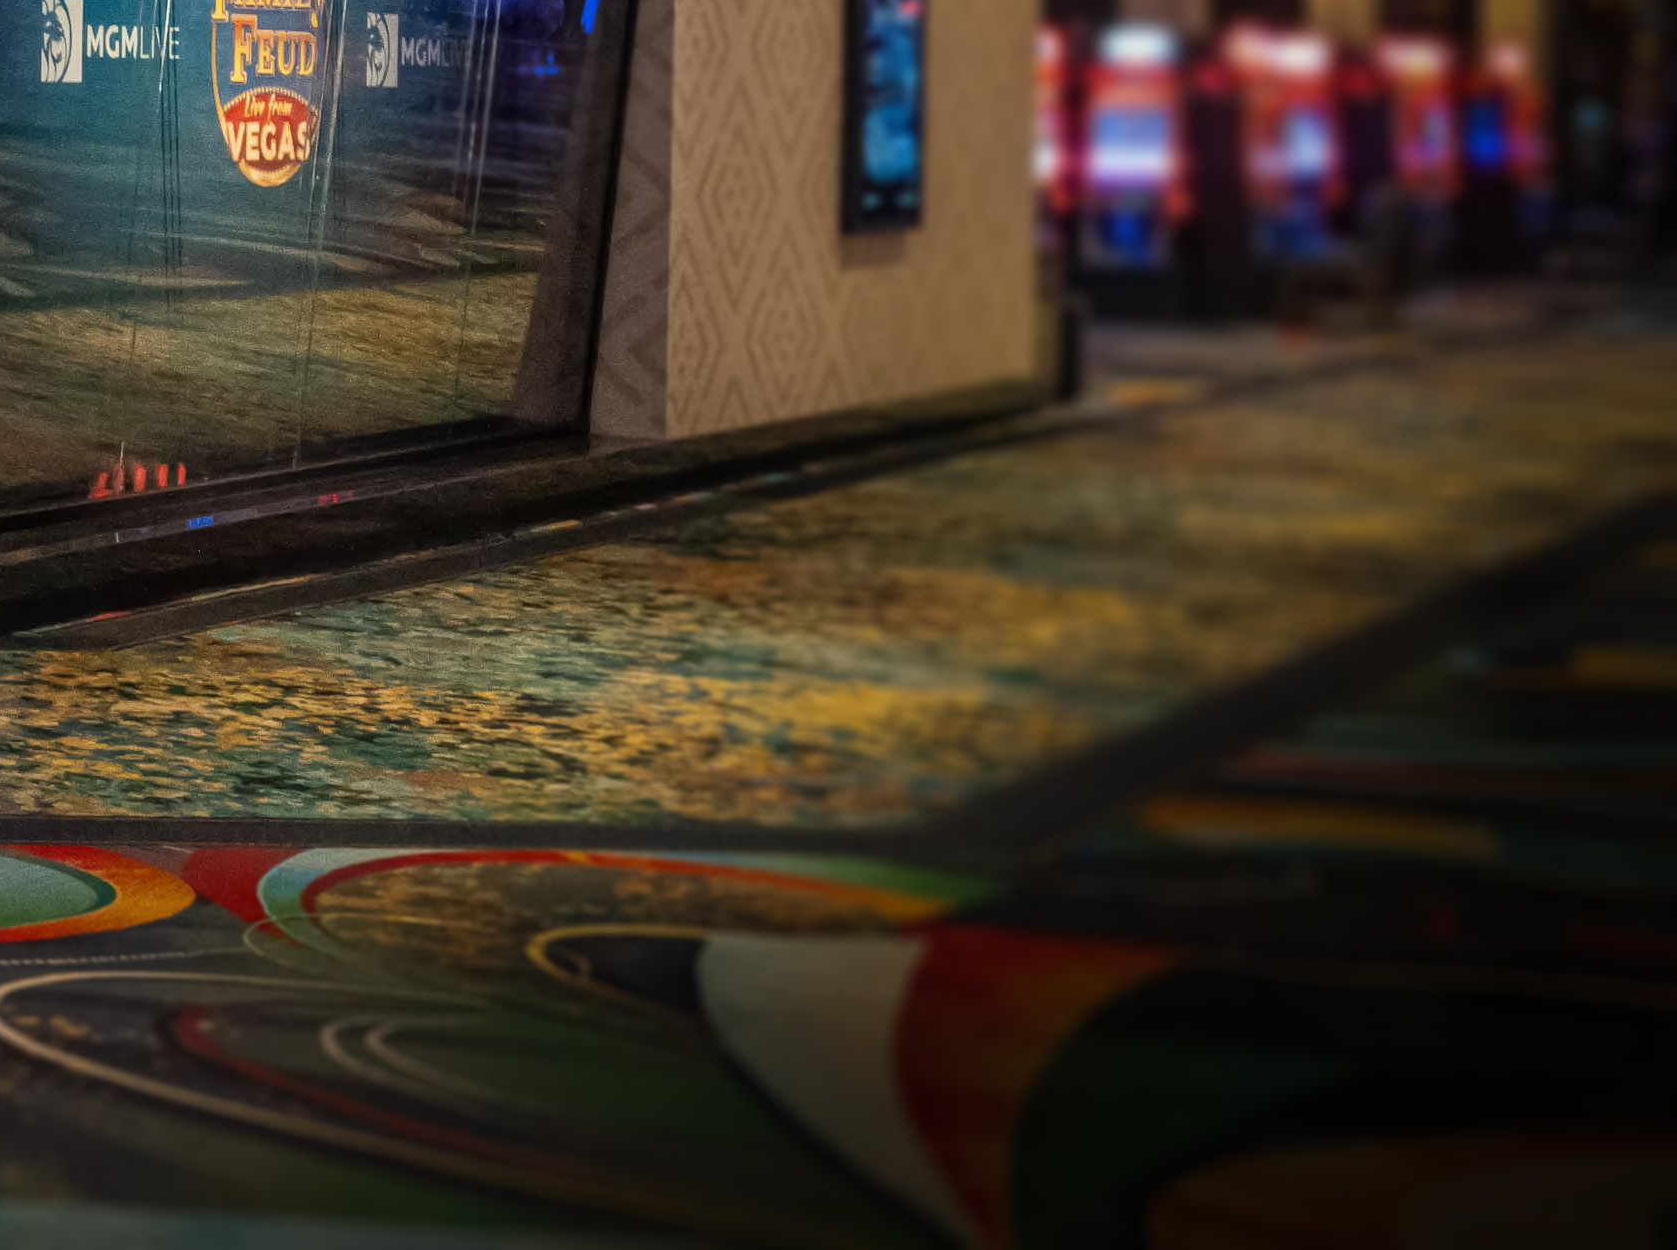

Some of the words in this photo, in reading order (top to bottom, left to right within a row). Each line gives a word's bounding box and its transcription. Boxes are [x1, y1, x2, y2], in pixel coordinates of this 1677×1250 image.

[86, 23, 180, 61] MGMLIVE
[229, 13, 318, 84] FEUD
[244, 94, 265, 118] Live
[266, 93, 293, 121] from
[226, 121, 312, 164] VEGAS
